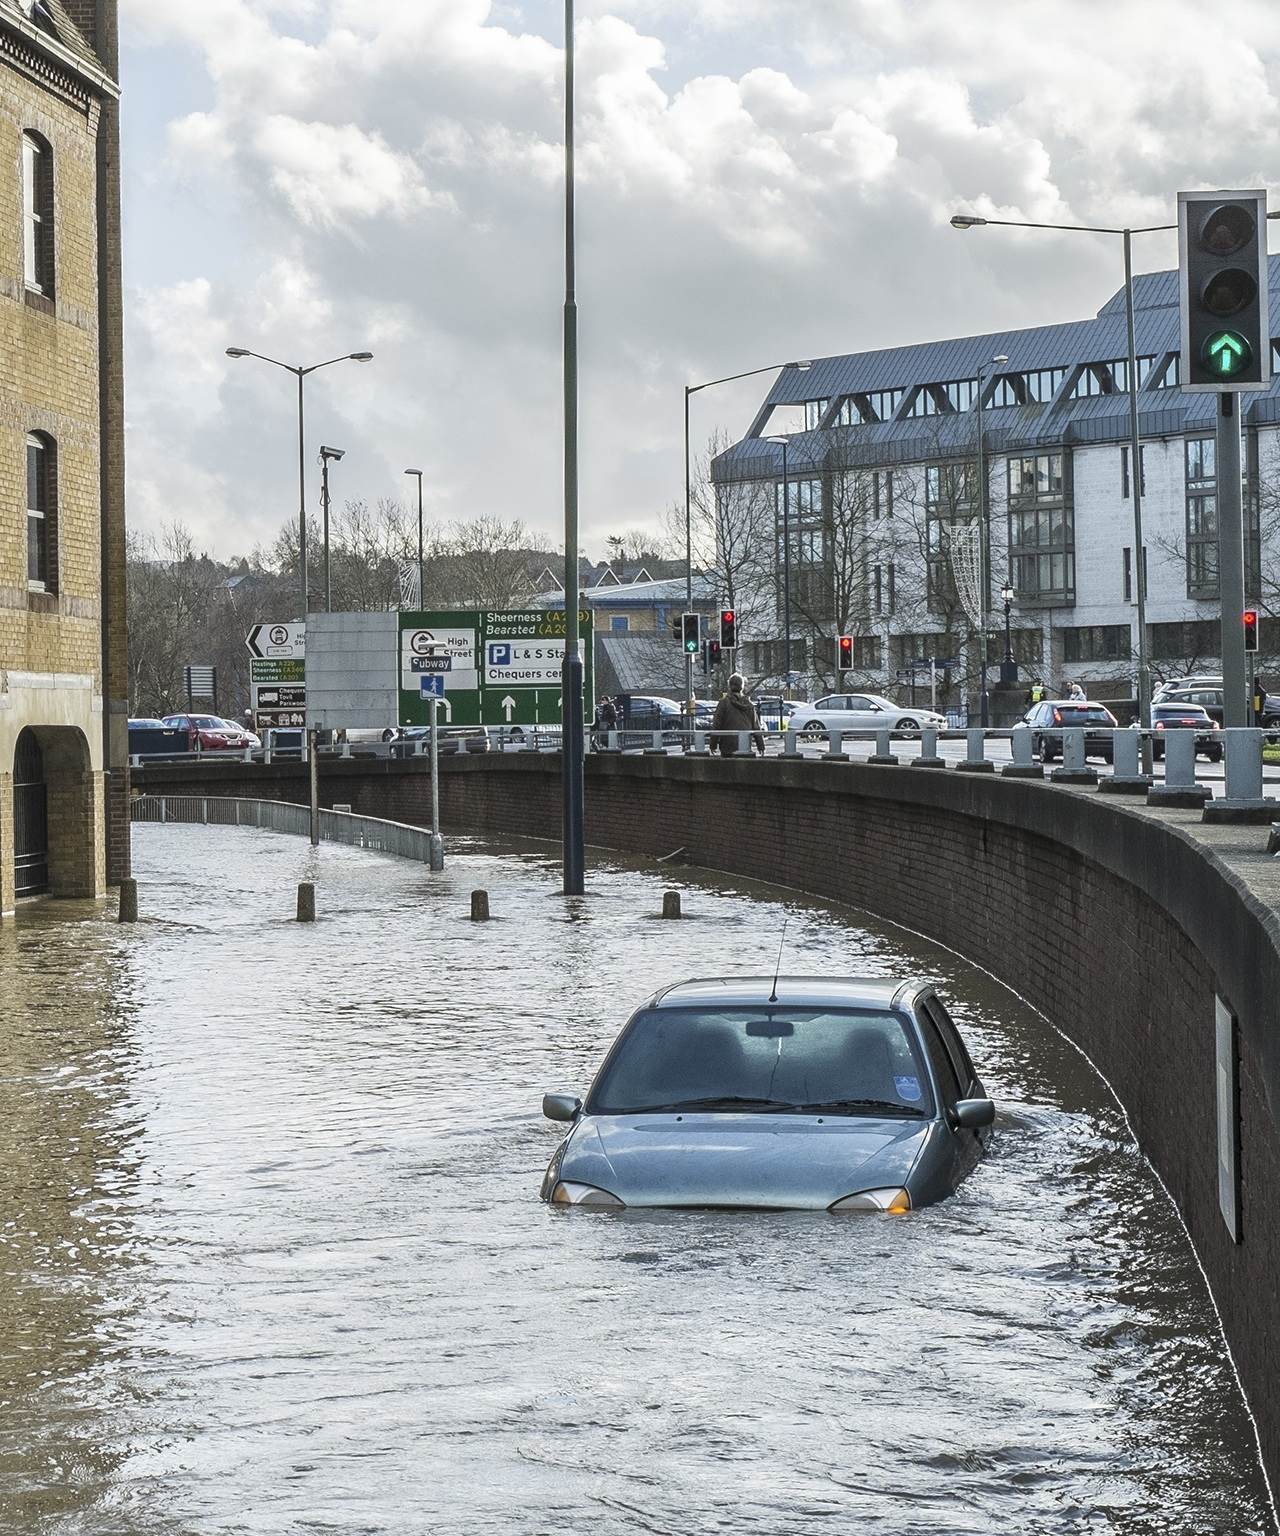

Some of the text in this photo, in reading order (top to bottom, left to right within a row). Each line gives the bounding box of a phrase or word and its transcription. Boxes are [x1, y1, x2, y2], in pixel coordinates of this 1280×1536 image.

[486, 610, 590, 623] Sheerness (A29)
[486, 625, 536, 635] Bearsted
[447, 637, 469, 647] High
[443, 649, 472, 658] Street
[492, 646, 506, 663] P
[513, 650, 520, 659] L
[523, 650, 531, 659] &
[535, 650, 543, 659] S
[412, 658, 450, 668] Subway
[488, 669, 542, 680] Chequers
